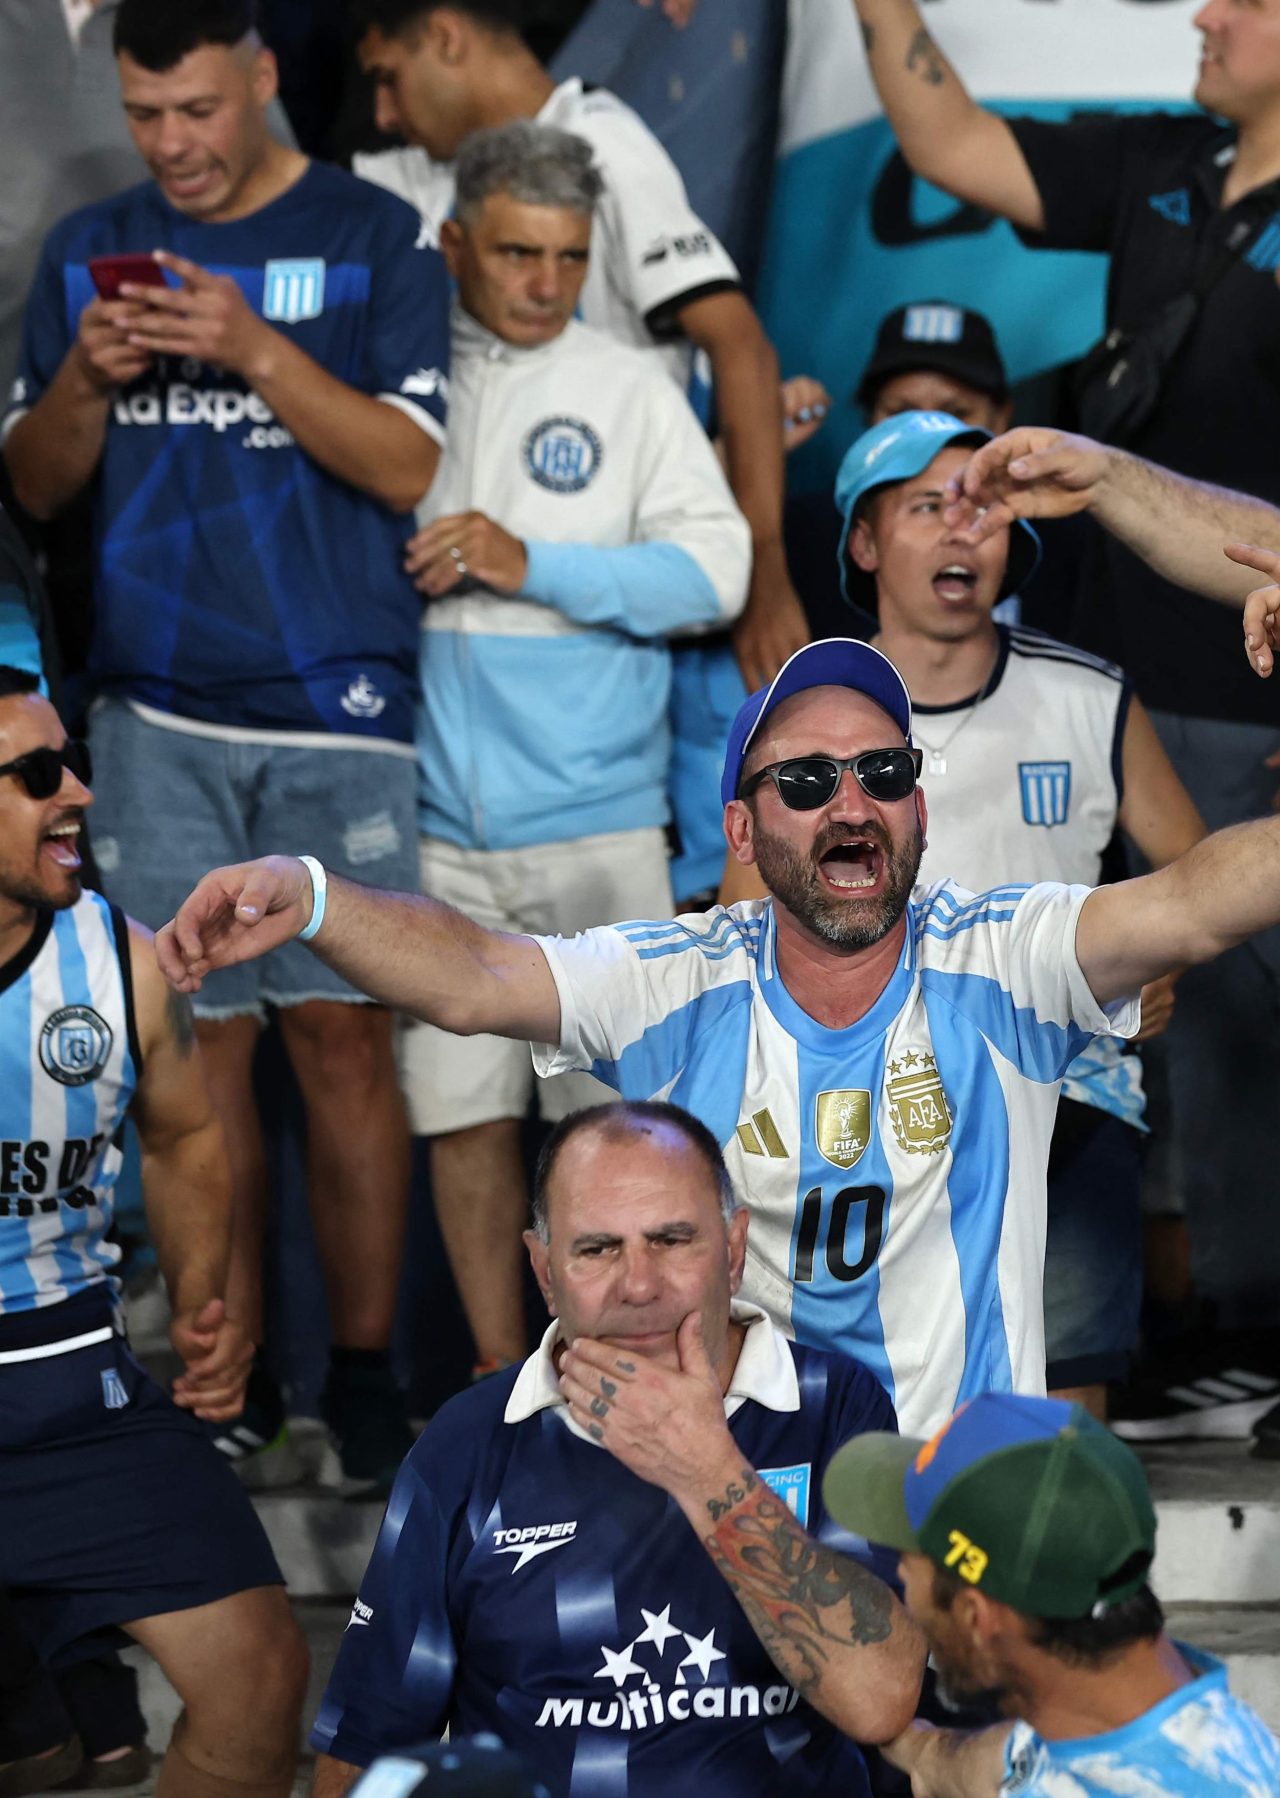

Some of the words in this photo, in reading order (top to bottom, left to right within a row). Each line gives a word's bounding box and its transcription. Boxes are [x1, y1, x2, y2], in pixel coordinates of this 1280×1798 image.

[833, 1138, 860, 1152] FIFA
[838, 1152, 855, 1161] 2022
[794, 1186, 886, 1282] 10
[493, 1520, 578, 1546] TOPPER
[943, 1530, 988, 1585] 73
